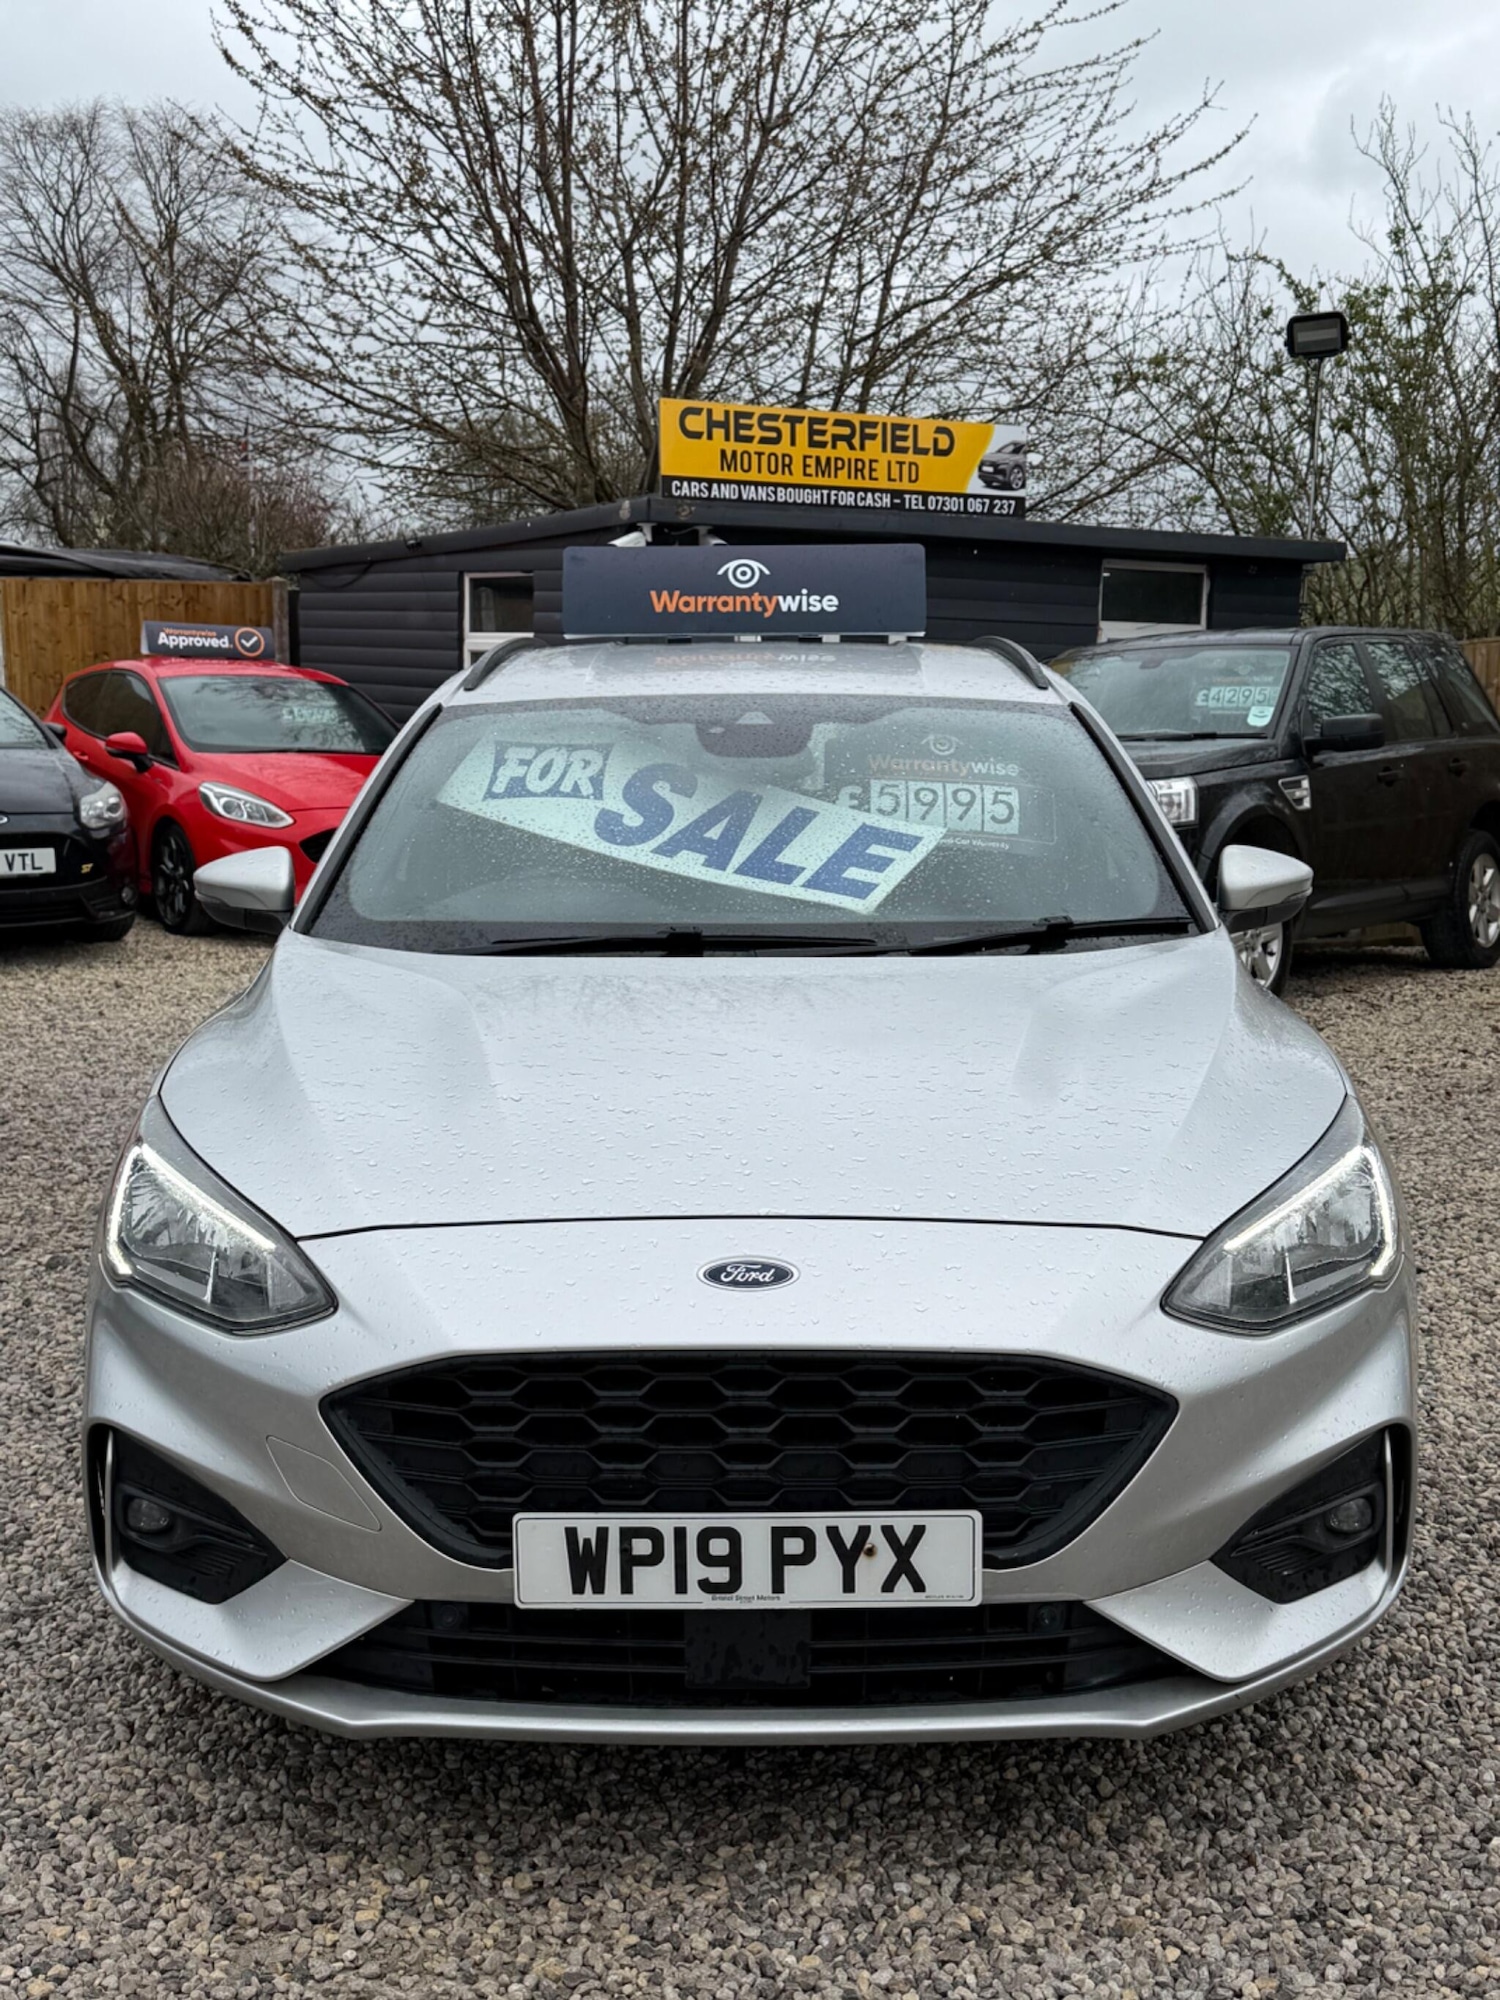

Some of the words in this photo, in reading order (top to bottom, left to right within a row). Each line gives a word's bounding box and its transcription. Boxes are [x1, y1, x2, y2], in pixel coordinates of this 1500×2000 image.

[679, 406, 955, 457] CHESTERFIELD
[720, 449, 793, 476] MOTOR
[803, 454, 879, 482] EMPIRE
[887, 460, 919, 484] LTD
[671, 480, 708, 498] CARS
[710, 483, 739, 500] AND
[740, 485, 777, 502] VANS
[777, 487, 830, 505] BOUGHT
[831, 490, 855, 506] FOR
[857, 492, 891, 508] CASH
[904, 494, 925, 510] TEL
[928, 496, 964, 512] 07301
[967, 498, 989, 513] 067
[993, 500, 1015, 515] 237
[650, 588, 839, 618] Warrantywise
[1194, 687, 1268, 707] £4295
[868, 754, 1020, 777] Warrantywise
[491, 746, 596, 797] FOR
[594, 763, 924, 900] SALE
[4, 852, 43, 872] VTL
[720, 1263, 776, 1282] Ford
[564, 1526, 743, 1596] WP19
[770, 1525, 926, 1594] PYX
